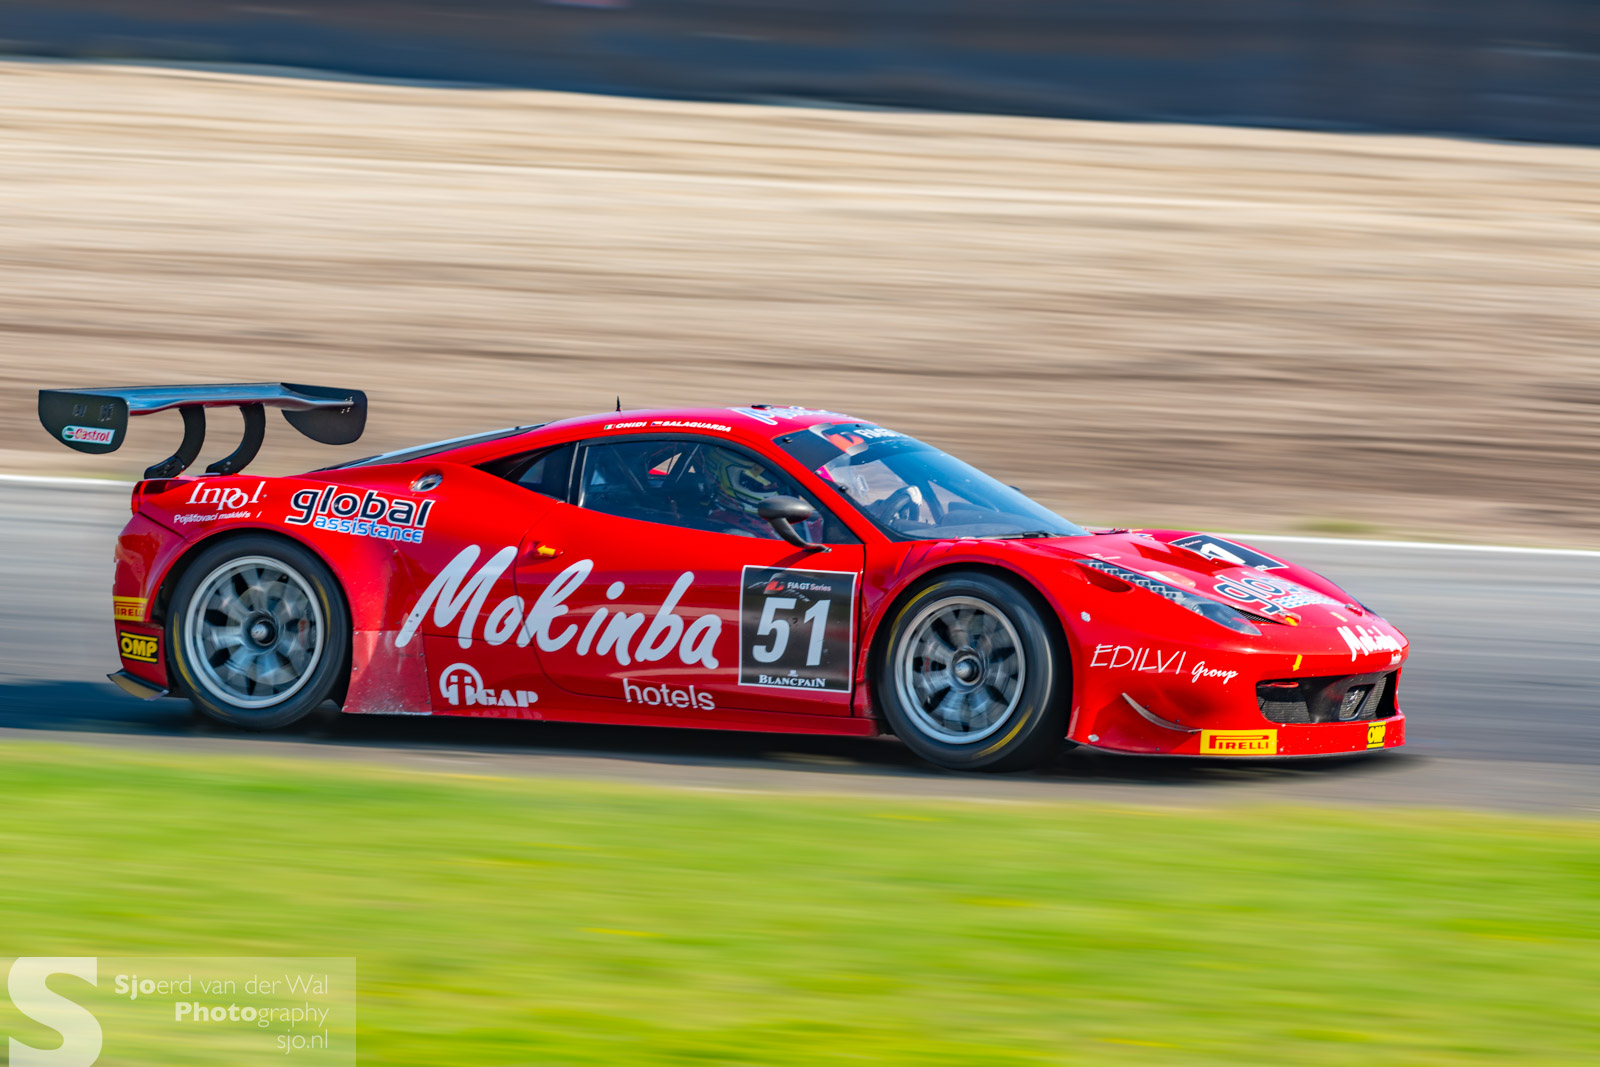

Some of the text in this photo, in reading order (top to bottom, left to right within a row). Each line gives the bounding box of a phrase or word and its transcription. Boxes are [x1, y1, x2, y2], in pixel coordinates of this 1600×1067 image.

[74, 428, 111, 442] Castrol
[185, 481, 266, 511] Inpol
[284, 485, 436, 528] global
[313, 515, 424, 544] assistance
[810, 583, 832, 592] Series
[752, 597, 831, 667] 51
[121, 637, 158, 657] OMP
[1090, 644, 1238, 685] EDILVI Group
[623, 678, 715, 711] hotels
[1209, 735, 1269, 750] PIRELLI
